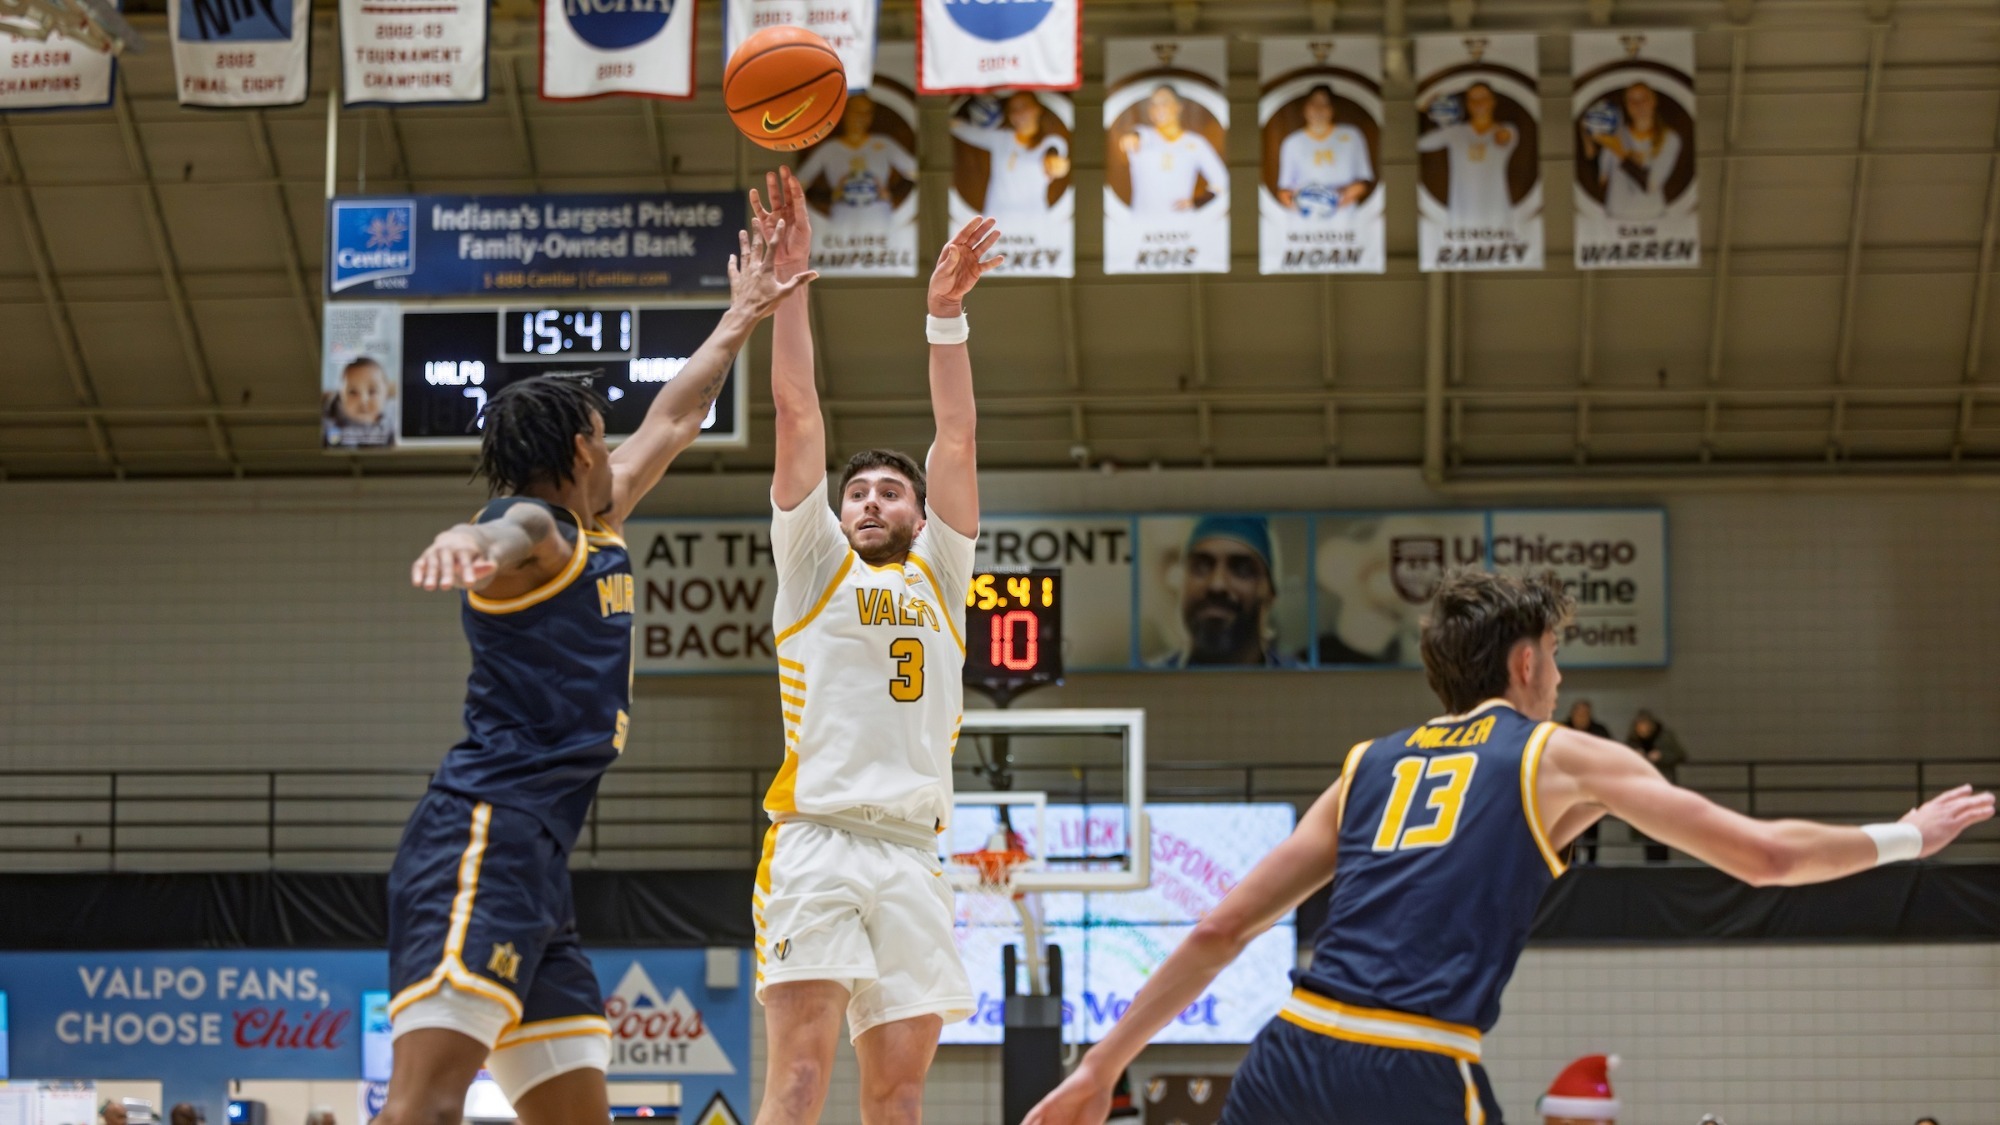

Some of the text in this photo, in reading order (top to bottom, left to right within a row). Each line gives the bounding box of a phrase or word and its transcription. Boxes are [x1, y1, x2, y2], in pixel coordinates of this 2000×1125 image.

[11, 50, 71, 68] SEASON
[355, 45, 461, 64] TOURNAMENT
[183, 73, 286, 94] FINAL EIGHT
[363, 71, 453, 88] CHAMPIONS
[432, 201, 723, 234] Indiana's Largest Private
[337, 247, 409, 269] Centier
[458, 230, 697, 266] Family-Owned Bank
[808, 249, 913, 269] AMPBELL
[1136, 246, 1198, 268] KOIS
[1281, 247, 1365, 269] MOAN
[1435, 244, 1530, 267] RAMEY
[1581, 240, 1697, 265] WARREN
[523, 309, 631, 355] 15:41
[424, 360, 485, 386] VALPO
[644, 533, 702, 568] AT
[645, 577, 764, 614] NOW
[644, 623, 773, 660] BACK
[990, 610, 1039, 671] 10
[1564, 622, 1638, 648] Point
[889, 637, 925, 703] 3
[1404, 714, 1498, 749] MILLER
[1371, 751, 1479, 852] 13
[77, 966, 332, 1009] VALPO FANS,
[55, 1006, 351, 1050] CHOOSE Chill
[610, 1042, 690, 1066] IGHT
